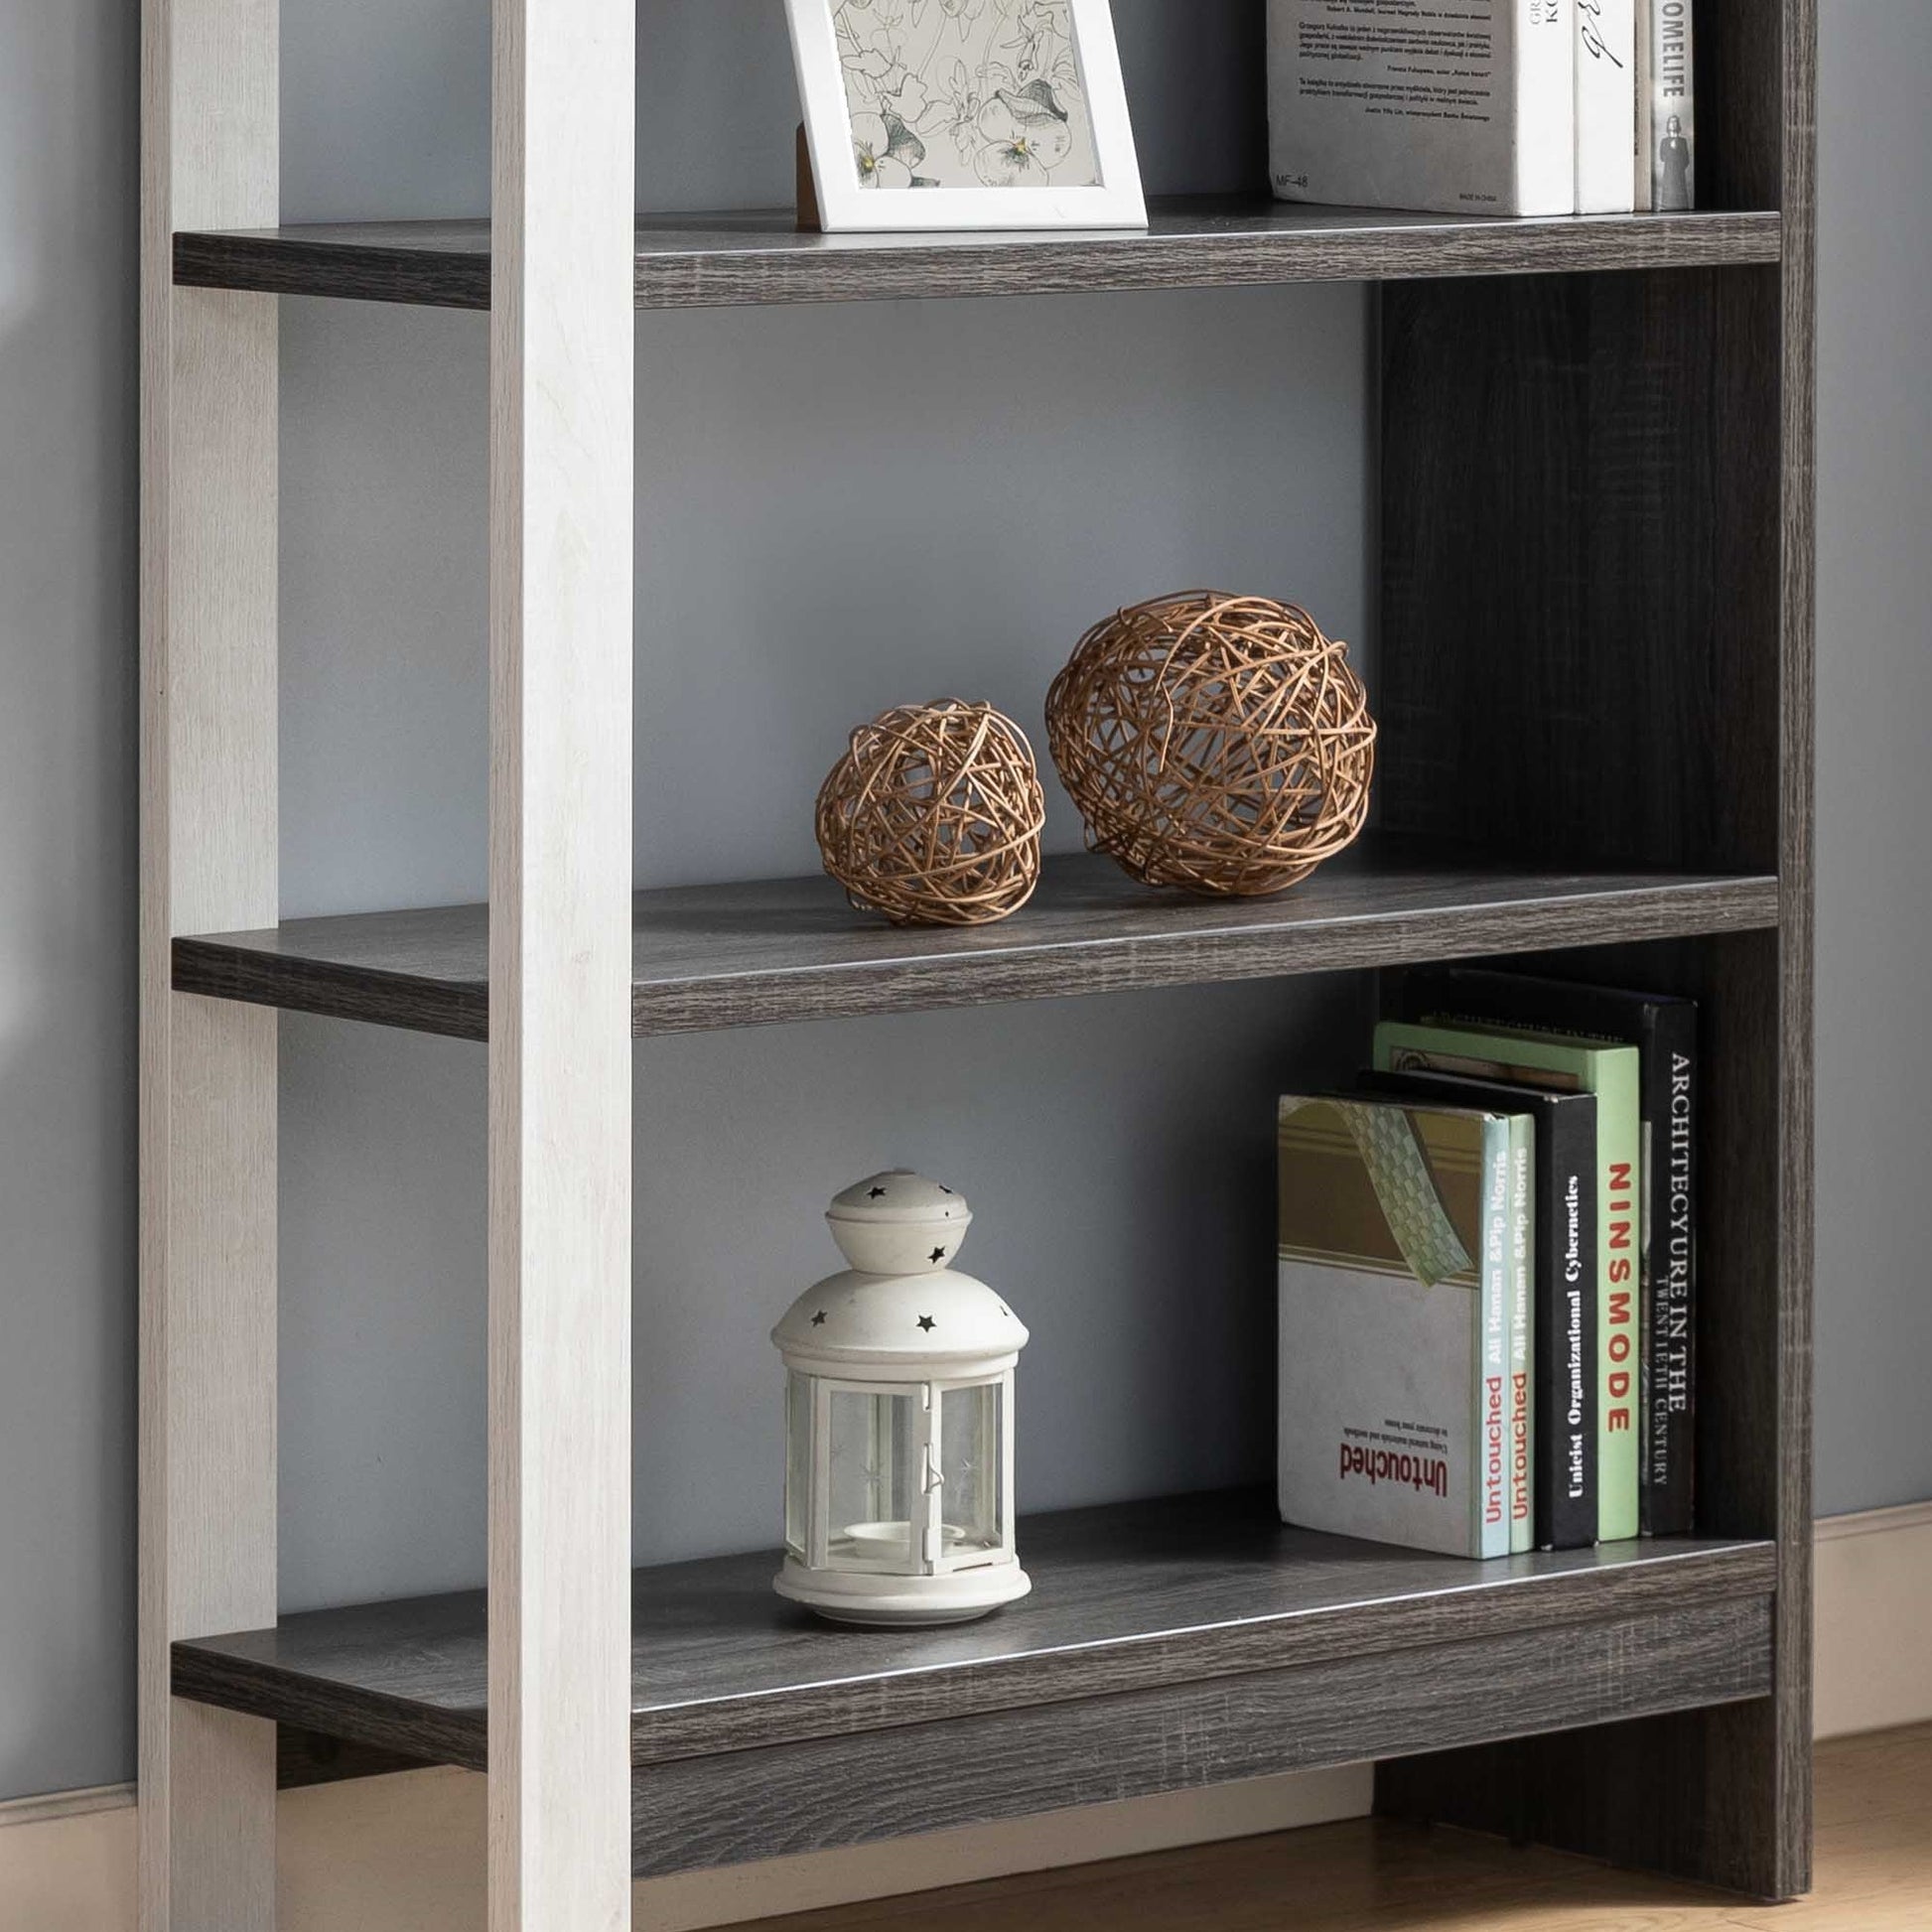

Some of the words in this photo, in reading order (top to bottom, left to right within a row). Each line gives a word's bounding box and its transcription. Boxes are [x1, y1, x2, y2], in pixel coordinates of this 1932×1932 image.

[1514, 1147, 1528, 1208] Norris
[1670, 1052, 1690, 1299] ARCHITECYURE
[1565, 1175, 1582, 1282] Cybernetics
[1608, 1163, 1631, 1433] NINSMODE
[1669, 1306, 1687, 1339] IN
[1567, 1291, 1584, 1425] Organizational
[1668, 1346, 1687, 1412] THE
[1340, 1443, 1448, 1498] Untouched
[1486, 1376, 1502, 1523] Untouched
[1512, 1373, 1528, 1520] Untouched
[1568, 1434, 1584, 1498] Unicist
[1654, 1398, 1668, 1485] CENTURY
